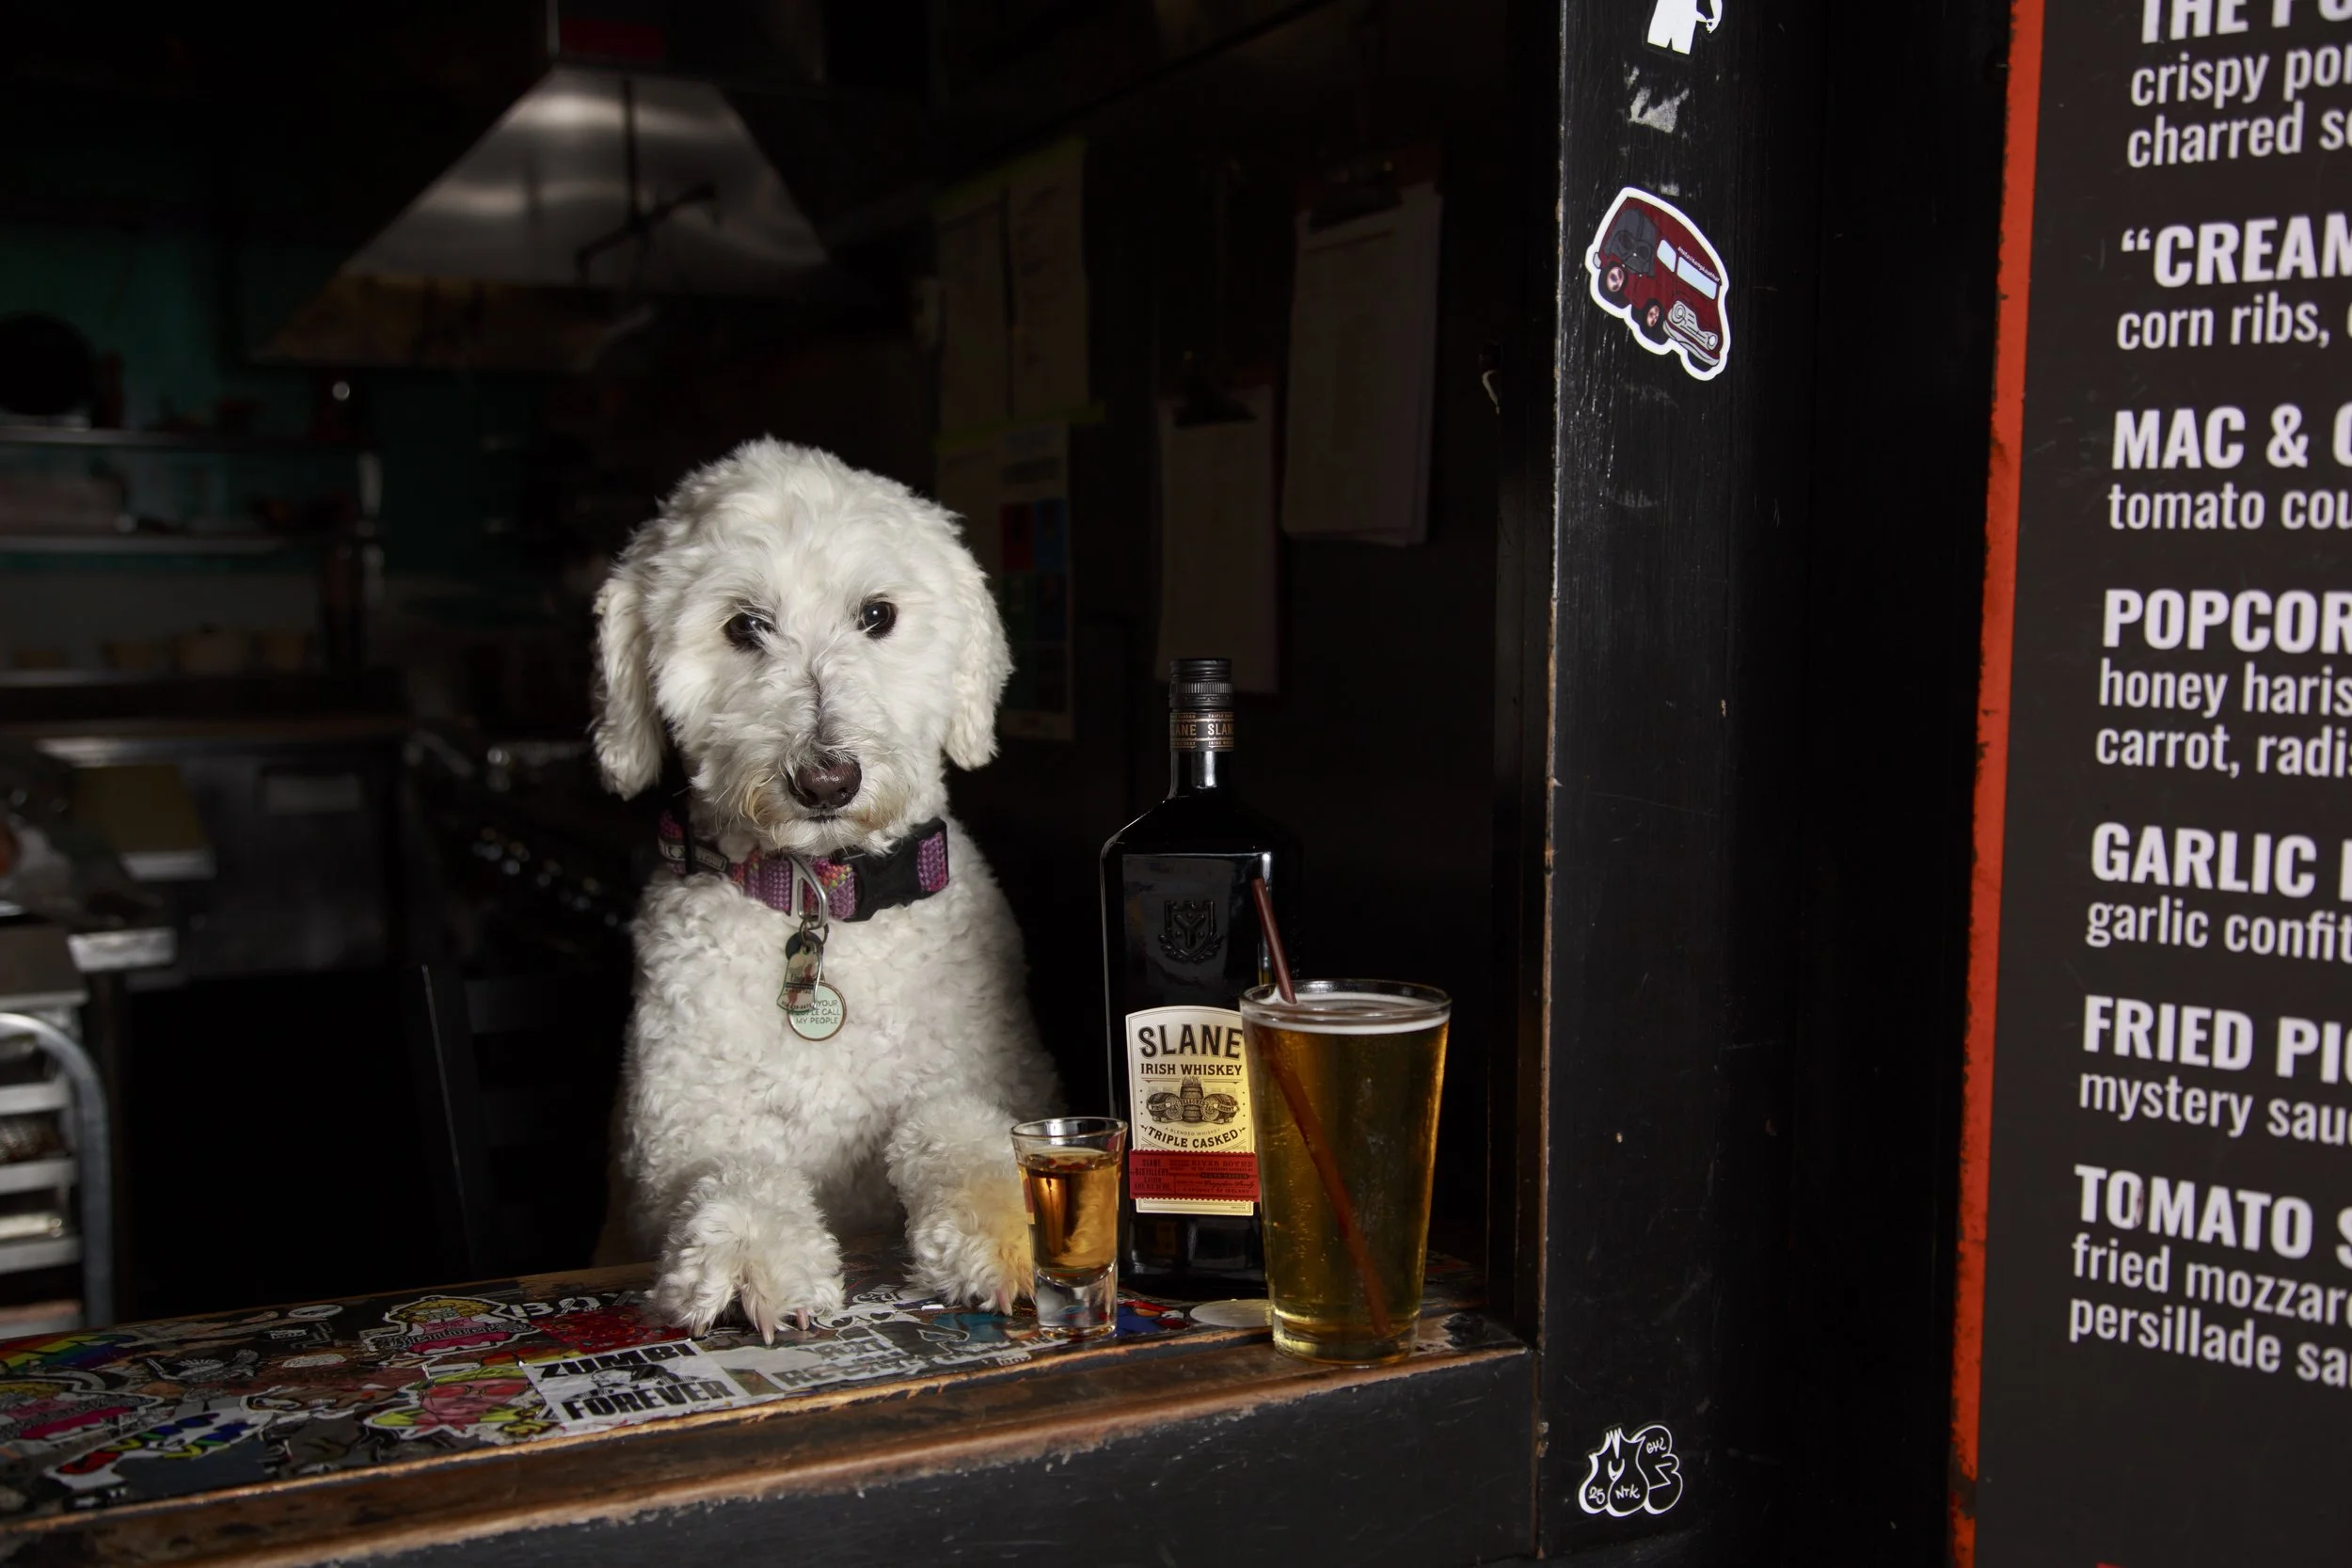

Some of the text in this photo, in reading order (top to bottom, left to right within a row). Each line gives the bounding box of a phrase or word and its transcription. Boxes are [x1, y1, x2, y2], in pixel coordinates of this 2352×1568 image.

[2131, 50, 2270, 107] crispy
[2127, 100, 2305, 168] charred
[2117, 305, 2215, 351] corn
[2230, 291, 2330, 348] ribs,
[2111, 406, 2246, 470] MAC
[2265, 404, 2309, 468] &
[2107, 482, 2265, 531] tomato
[2103, 588, 2352, 655] POPCOR
[2099, 657, 2352, 719] honey haris
[2095, 723, 2352, 779] carrot, radi
[2090, 821, 2317, 898] GARLIC
[2085, 895, 2352, 964] garlic confit
[1137, 1022, 1243, 1061] SLANE
[1140, 1063, 1243, 1076] IRISH WHISKEY
[2083, 994, 2352, 1085] FRIED PI
[1148, 1125, 1239, 1148] TRIPLE CASKED
[2079, 1072, 2352, 1146] mystery sau
[2074, 1164, 2313, 1259] TOMATO
[2072, 1232, 2352, 1328] fried mozzar
[535, 1342, 698, 1379] ZUMBI
[2069, 1298, 2352, 1388] persillade sa
[561, 1379, 736, 1421] FOREVER
[1614, 1482, 1641, 1500] NTK
